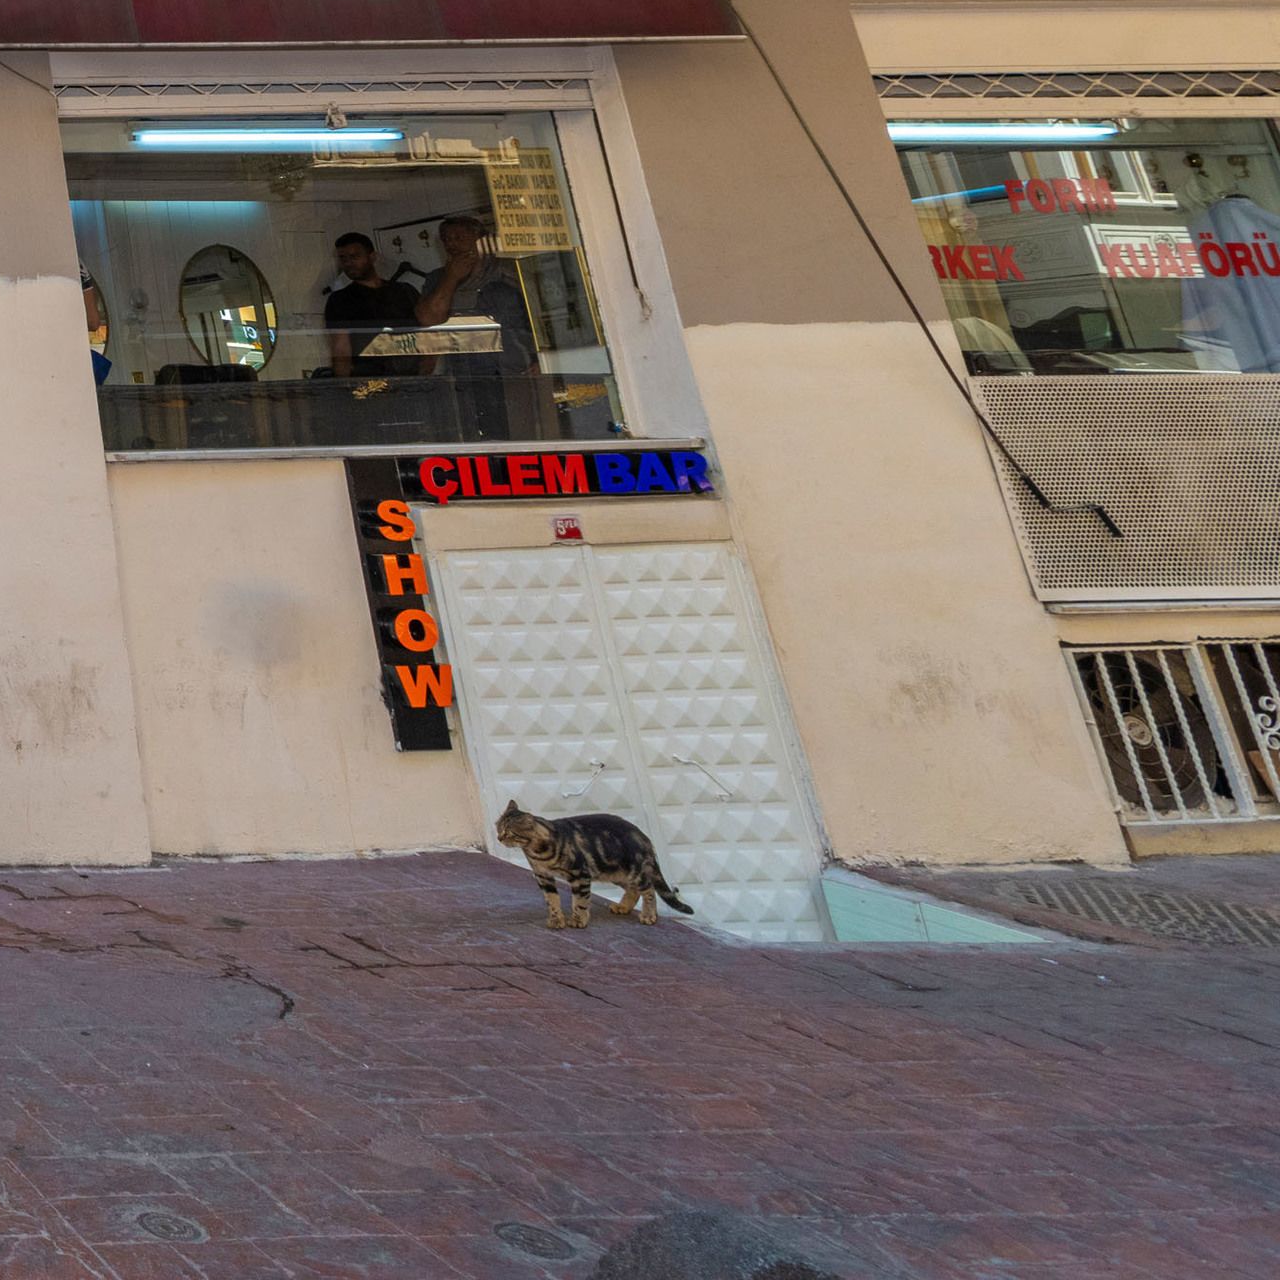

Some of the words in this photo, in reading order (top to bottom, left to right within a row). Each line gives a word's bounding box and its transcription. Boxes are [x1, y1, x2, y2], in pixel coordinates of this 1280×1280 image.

[1004, 177, 1118, 214] FORM
[927, 244, 1025, 281] RKEK
[594, 451, 715, 494] BAR
[375, 498, 454, 709] SHOW
